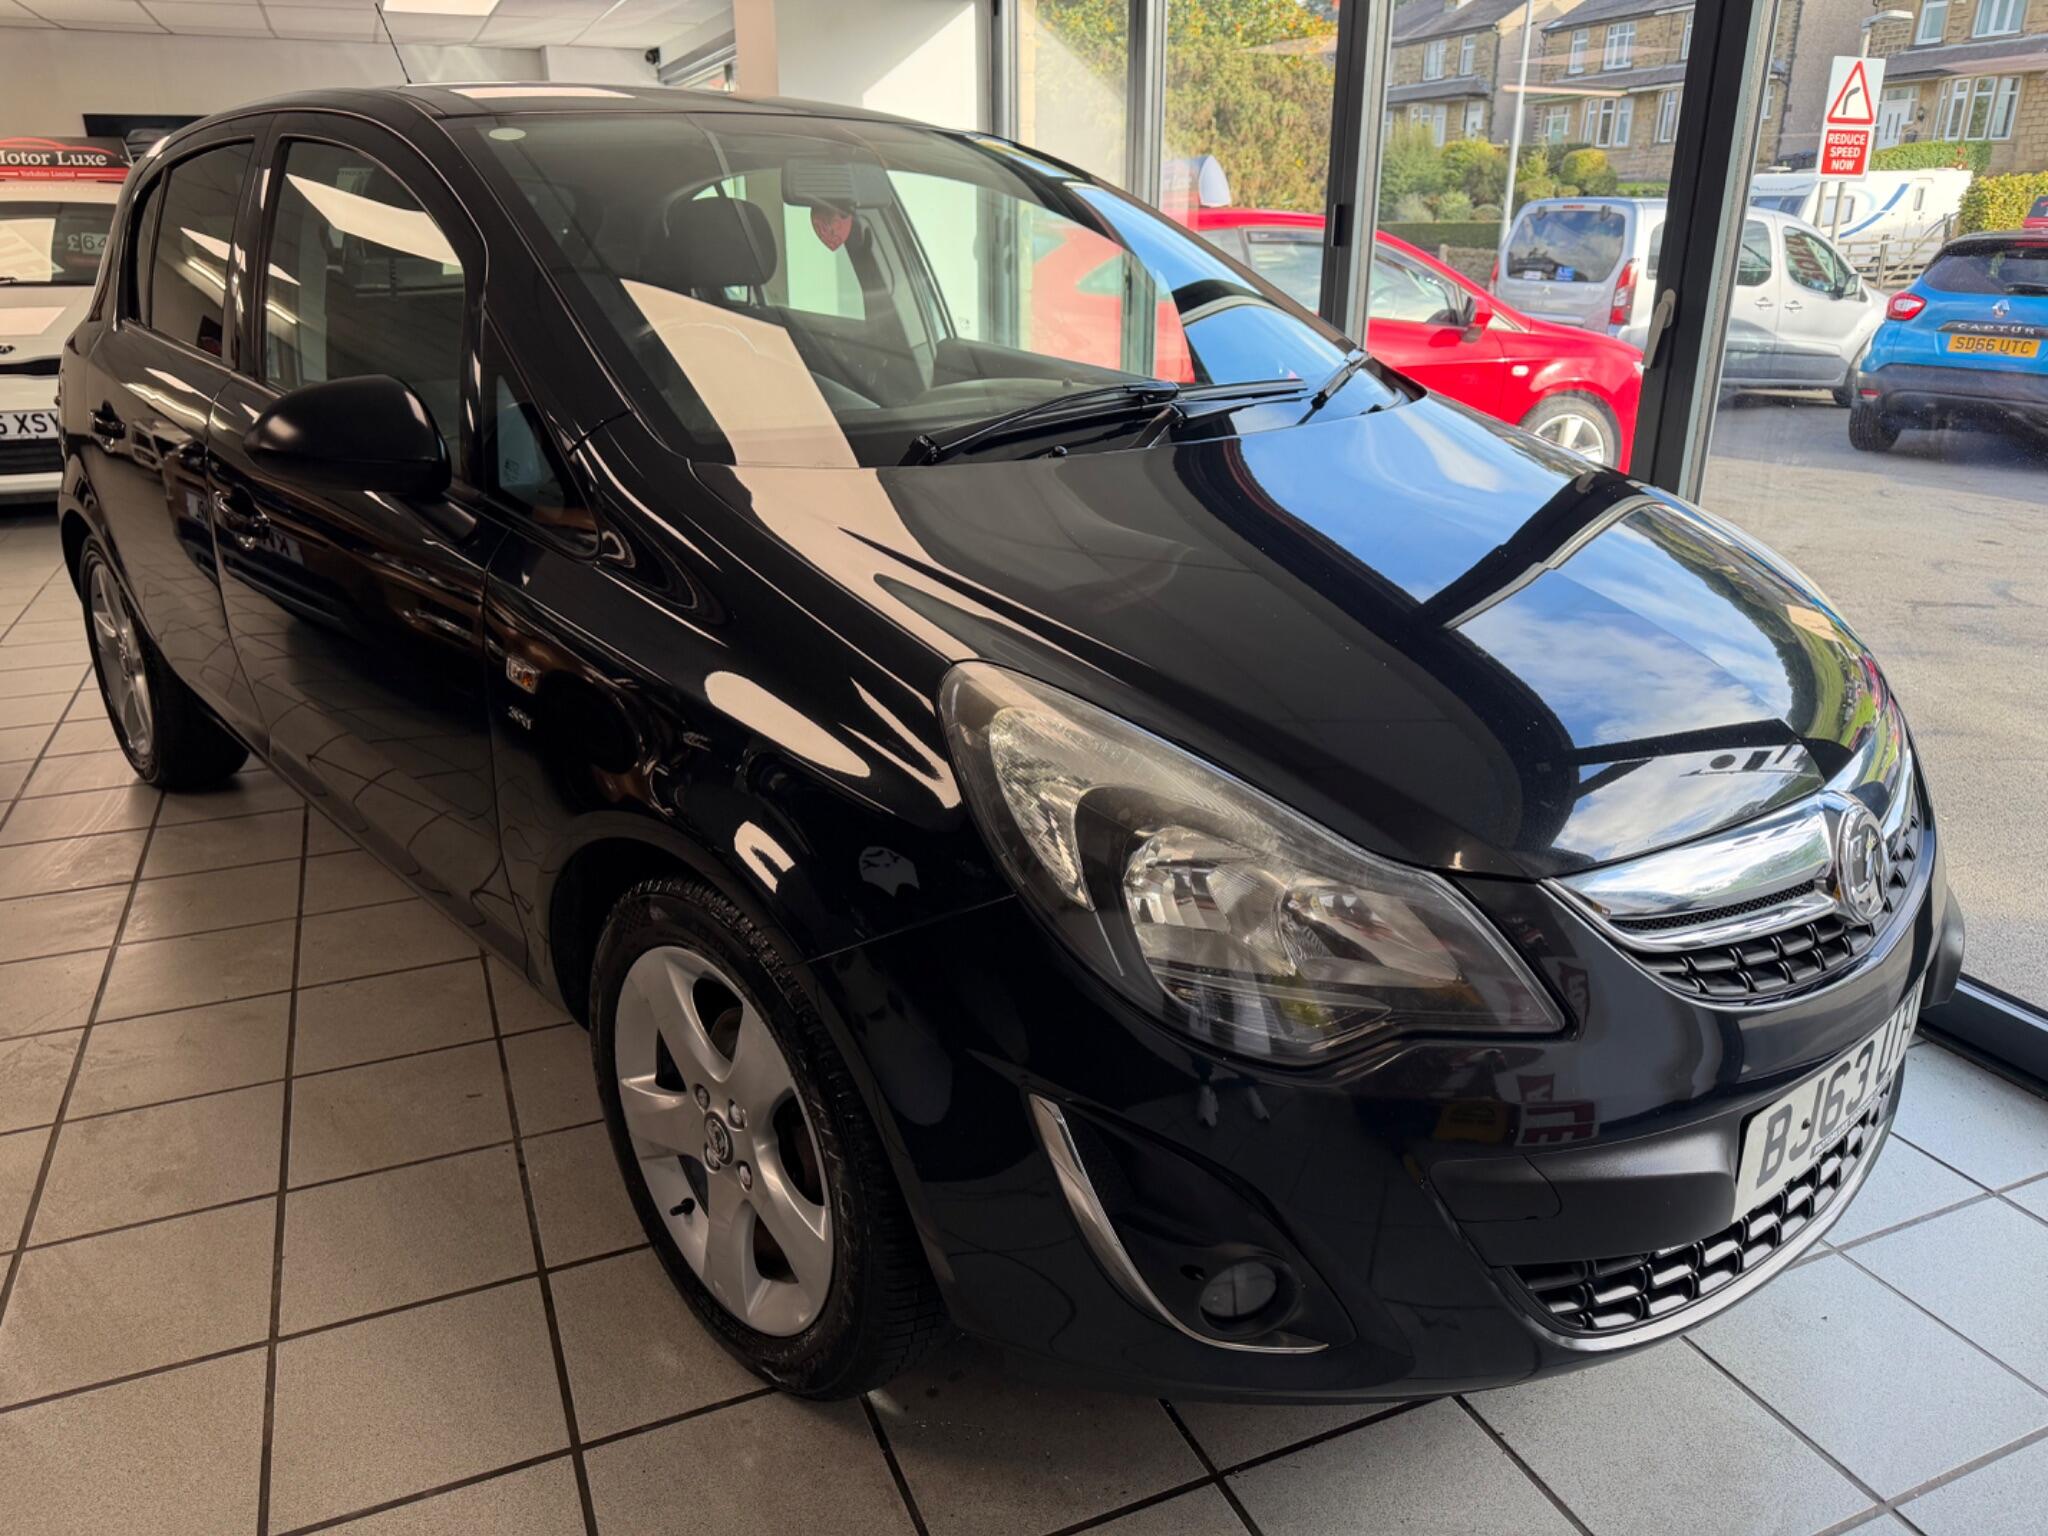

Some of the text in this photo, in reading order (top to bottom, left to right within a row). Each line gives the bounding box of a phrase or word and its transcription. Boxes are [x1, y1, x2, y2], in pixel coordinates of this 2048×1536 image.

[1827, 133, 1866, 145] REDUCE
[1830, 146, 1861, 158] SPEED
[56, 151, 107, 166] Luxe
[1830, 160, 1856, 170] NOW
[1958, 323, 2035, 335] CAPTUR
[1954, 336, 2032, 354] SD66 UTC
[1756, 1040, 1875, 1188] BJ63
